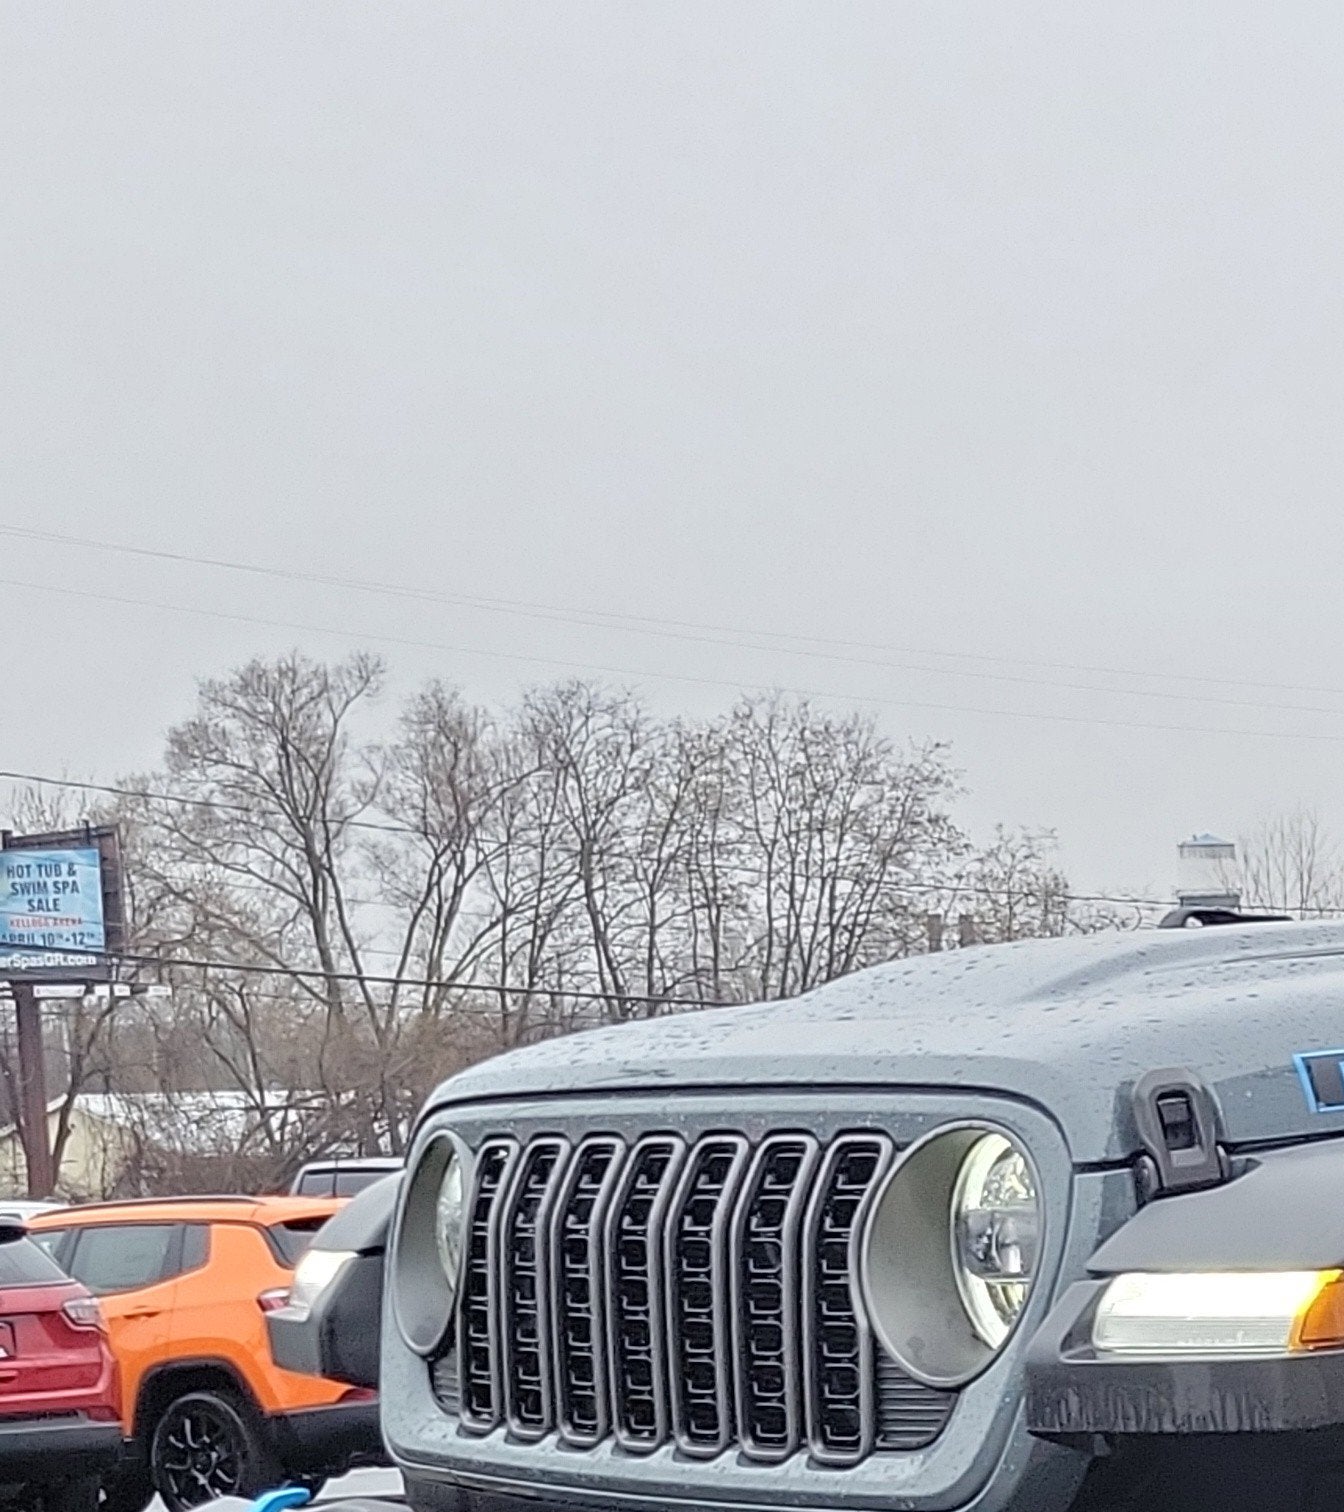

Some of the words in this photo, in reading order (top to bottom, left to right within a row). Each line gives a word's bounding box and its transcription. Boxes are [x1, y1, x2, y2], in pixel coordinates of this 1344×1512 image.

[6, 863, 33, 879] HOT
[36, 862, 62, 879] TUB
[67, 861, 78, 878] &
[10, 881, 49, 897] SWIM
[53, 880, 80, 895] SPA
[27, 897, 62, 912] SALE
